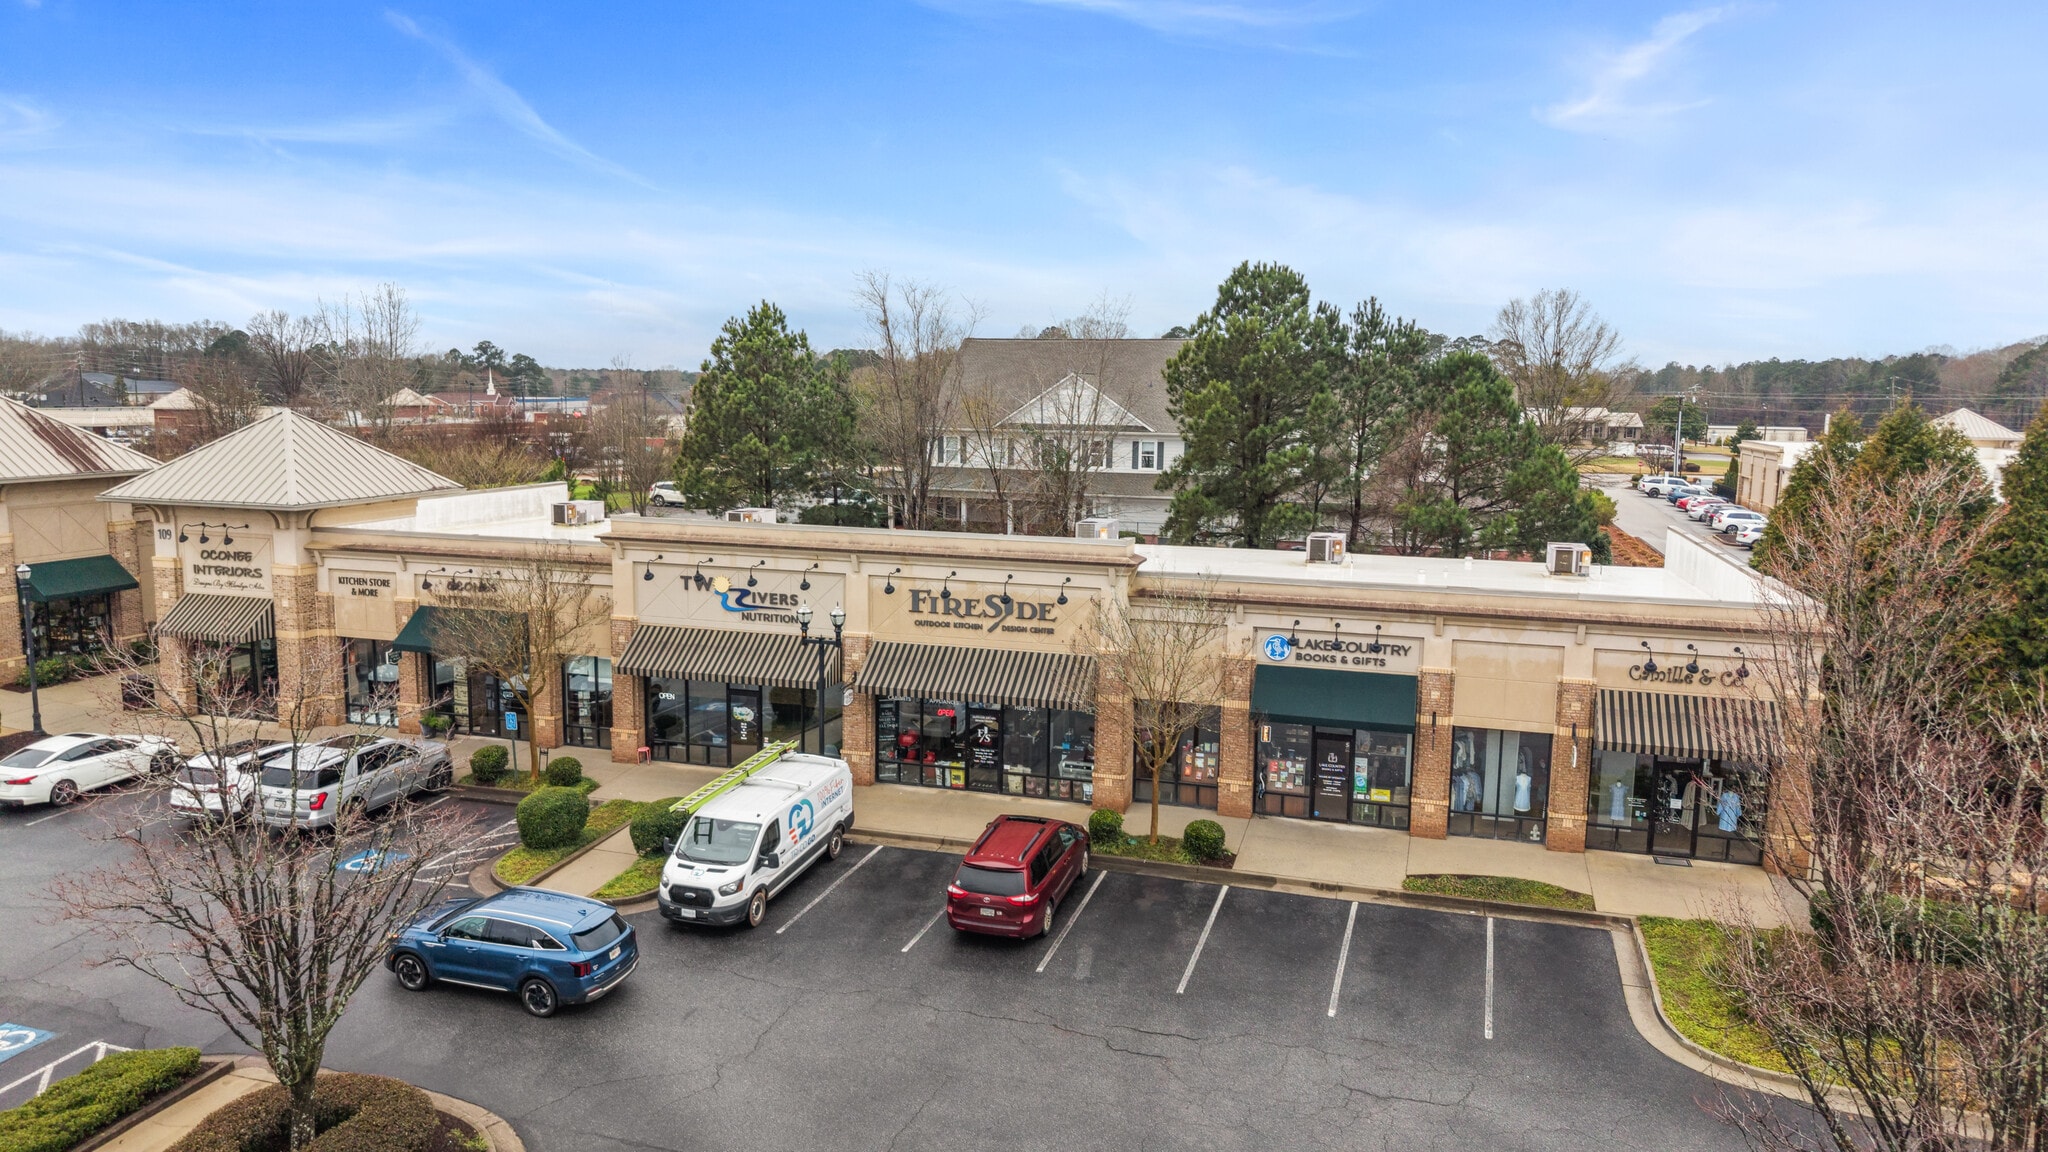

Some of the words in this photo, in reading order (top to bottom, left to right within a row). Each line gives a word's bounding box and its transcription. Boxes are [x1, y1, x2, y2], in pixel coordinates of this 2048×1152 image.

[158, 528, 172, 540] 109
[200, 550, 253, 562] OCONEE
[193, 564, 263, 579] INTERIORS
[338, 576, 368, 586] KITCHEN
[369, 578, 391, 588] STORE
[351, 587, 357, 596] &
[358, 588, 379, 597] MORE
[741, 612, 799, 624] NUTRITION
[914, 619, 951, 629] OUTDOOR
[953, 622, 983, 631] KITCHEN
[1001, 625, 1027, 634] DESIGN
[1029, 627, 1055, 635] CENTER
[1295, 638, 1332, 652] LAKE
[1334, 641, 1412, 657] COUTRY
[1296, 652, 1337, 664] BOOKS
[1340, 655, 1348, 665] &
[1352, 656, 1387, 667] GIFTS
[1699, 668, 1716, 686] &
[658, 692, 676, 700] OPEN
[936, 708, 956, 718] OPEN
